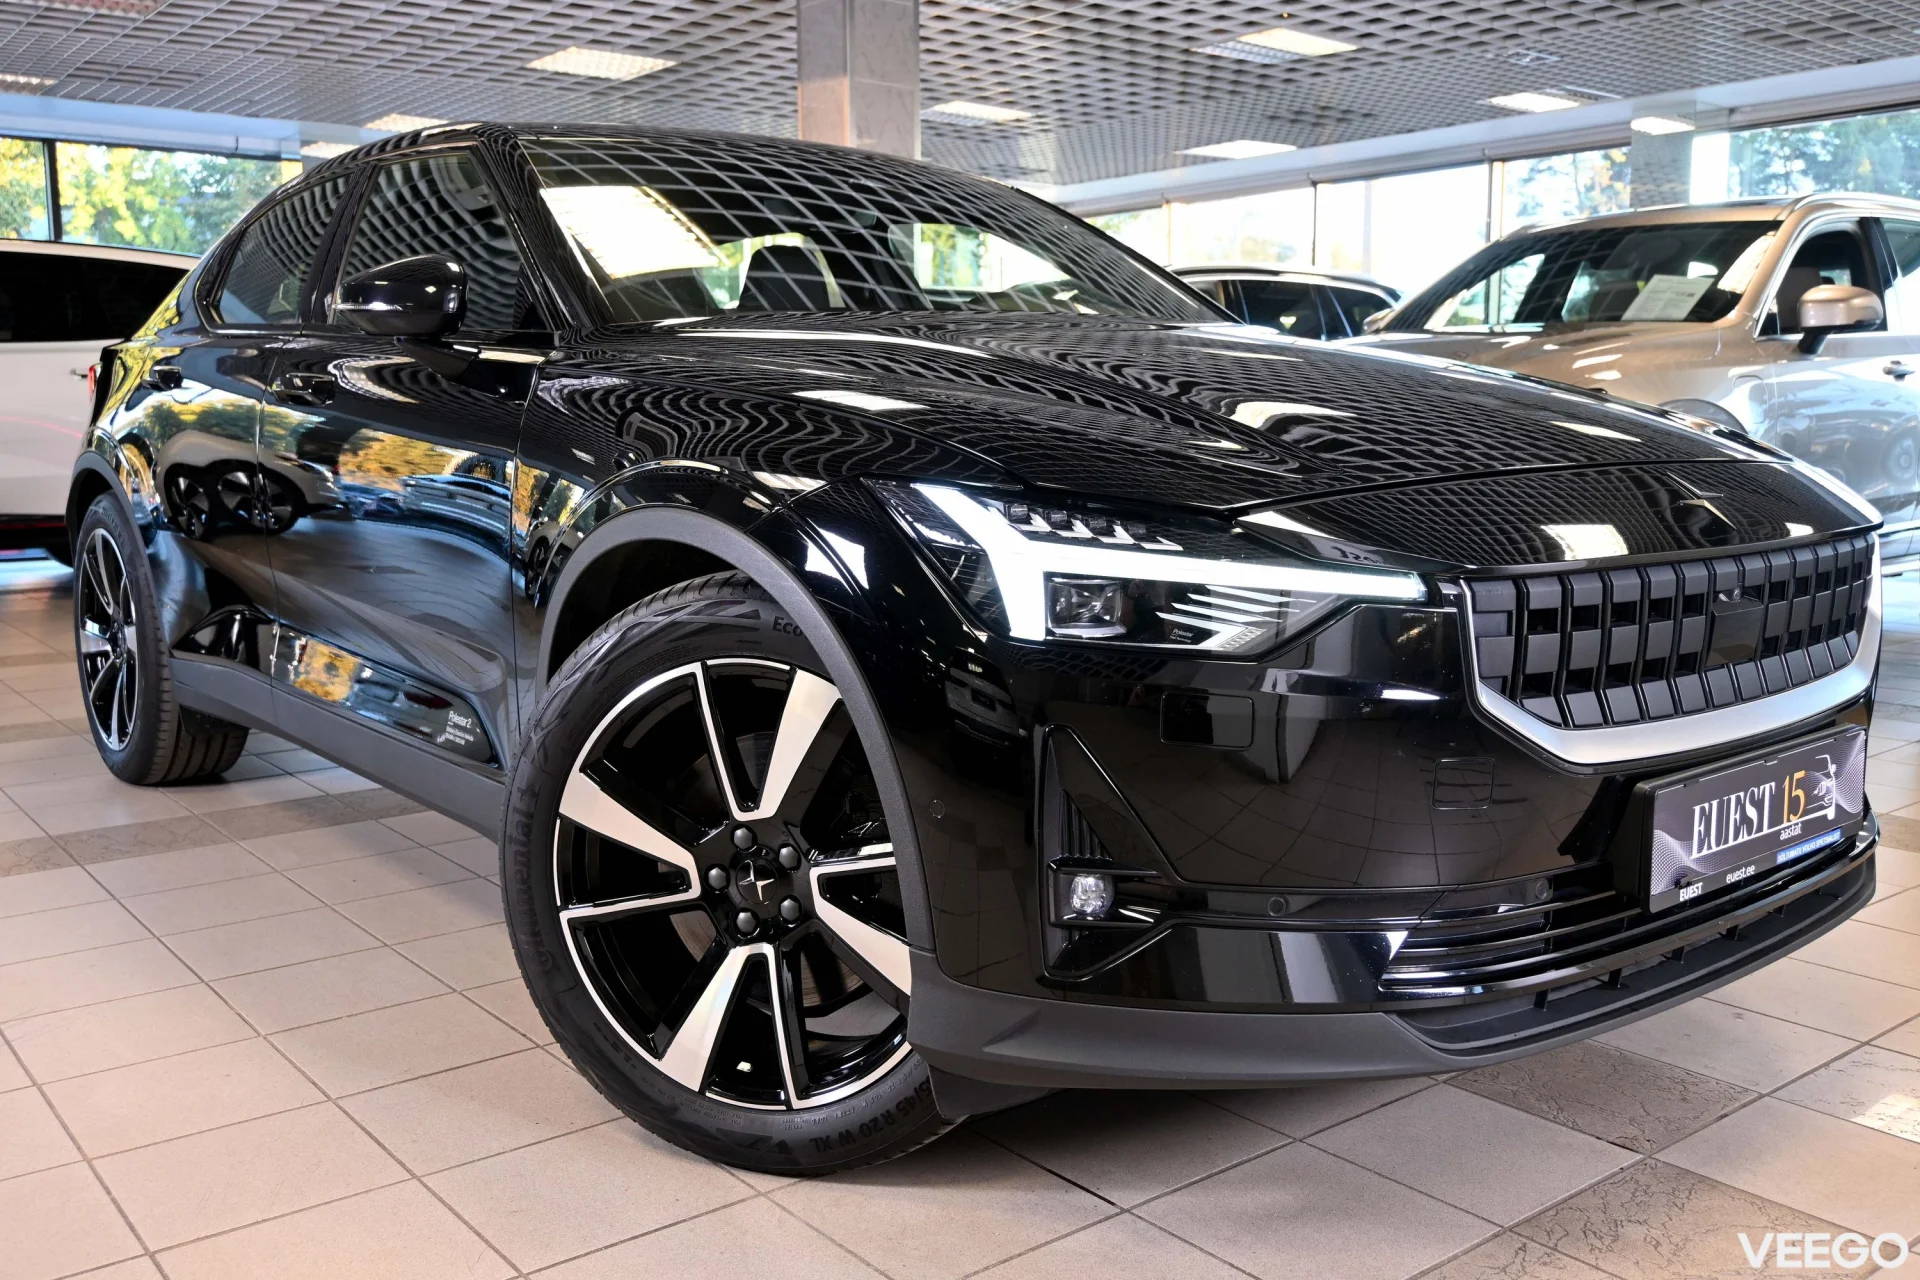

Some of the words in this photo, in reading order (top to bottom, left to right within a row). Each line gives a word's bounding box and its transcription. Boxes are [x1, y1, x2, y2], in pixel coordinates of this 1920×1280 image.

[467, 718, 472, 728] 2
[1690, 782, 1775, 859] EUEST
[1782, 770, 1806, 824] 15
[1780, 822, 1802, 840] aastat
[1726, 865, 1755, 883] euest.ee
[1680, 882, 1703, 901] EUEST
[809, 1135, 834, 1153] XL
